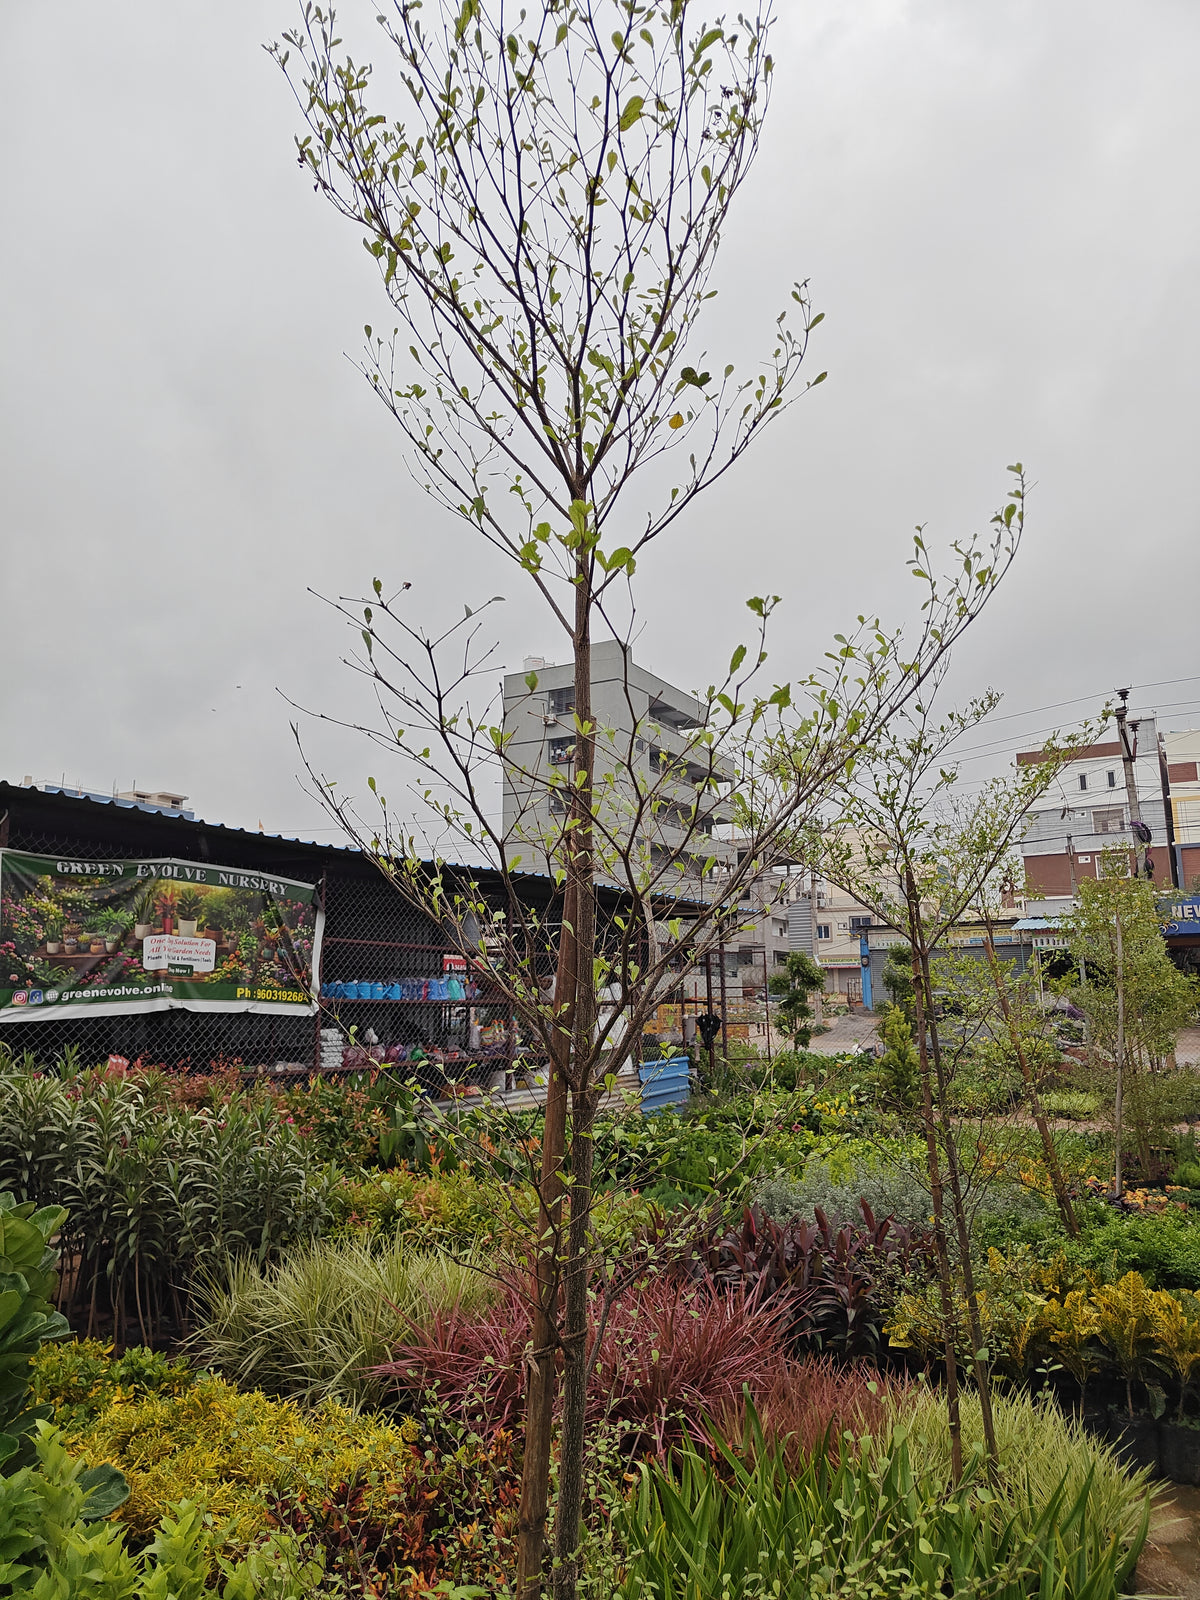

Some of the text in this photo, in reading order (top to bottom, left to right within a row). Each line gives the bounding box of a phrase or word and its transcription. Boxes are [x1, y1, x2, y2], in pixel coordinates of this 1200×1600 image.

[56, 861, 289, 896] GREEN EVOLVE NURSERY
[61, 982, 173, 1001] greenevolve.online
